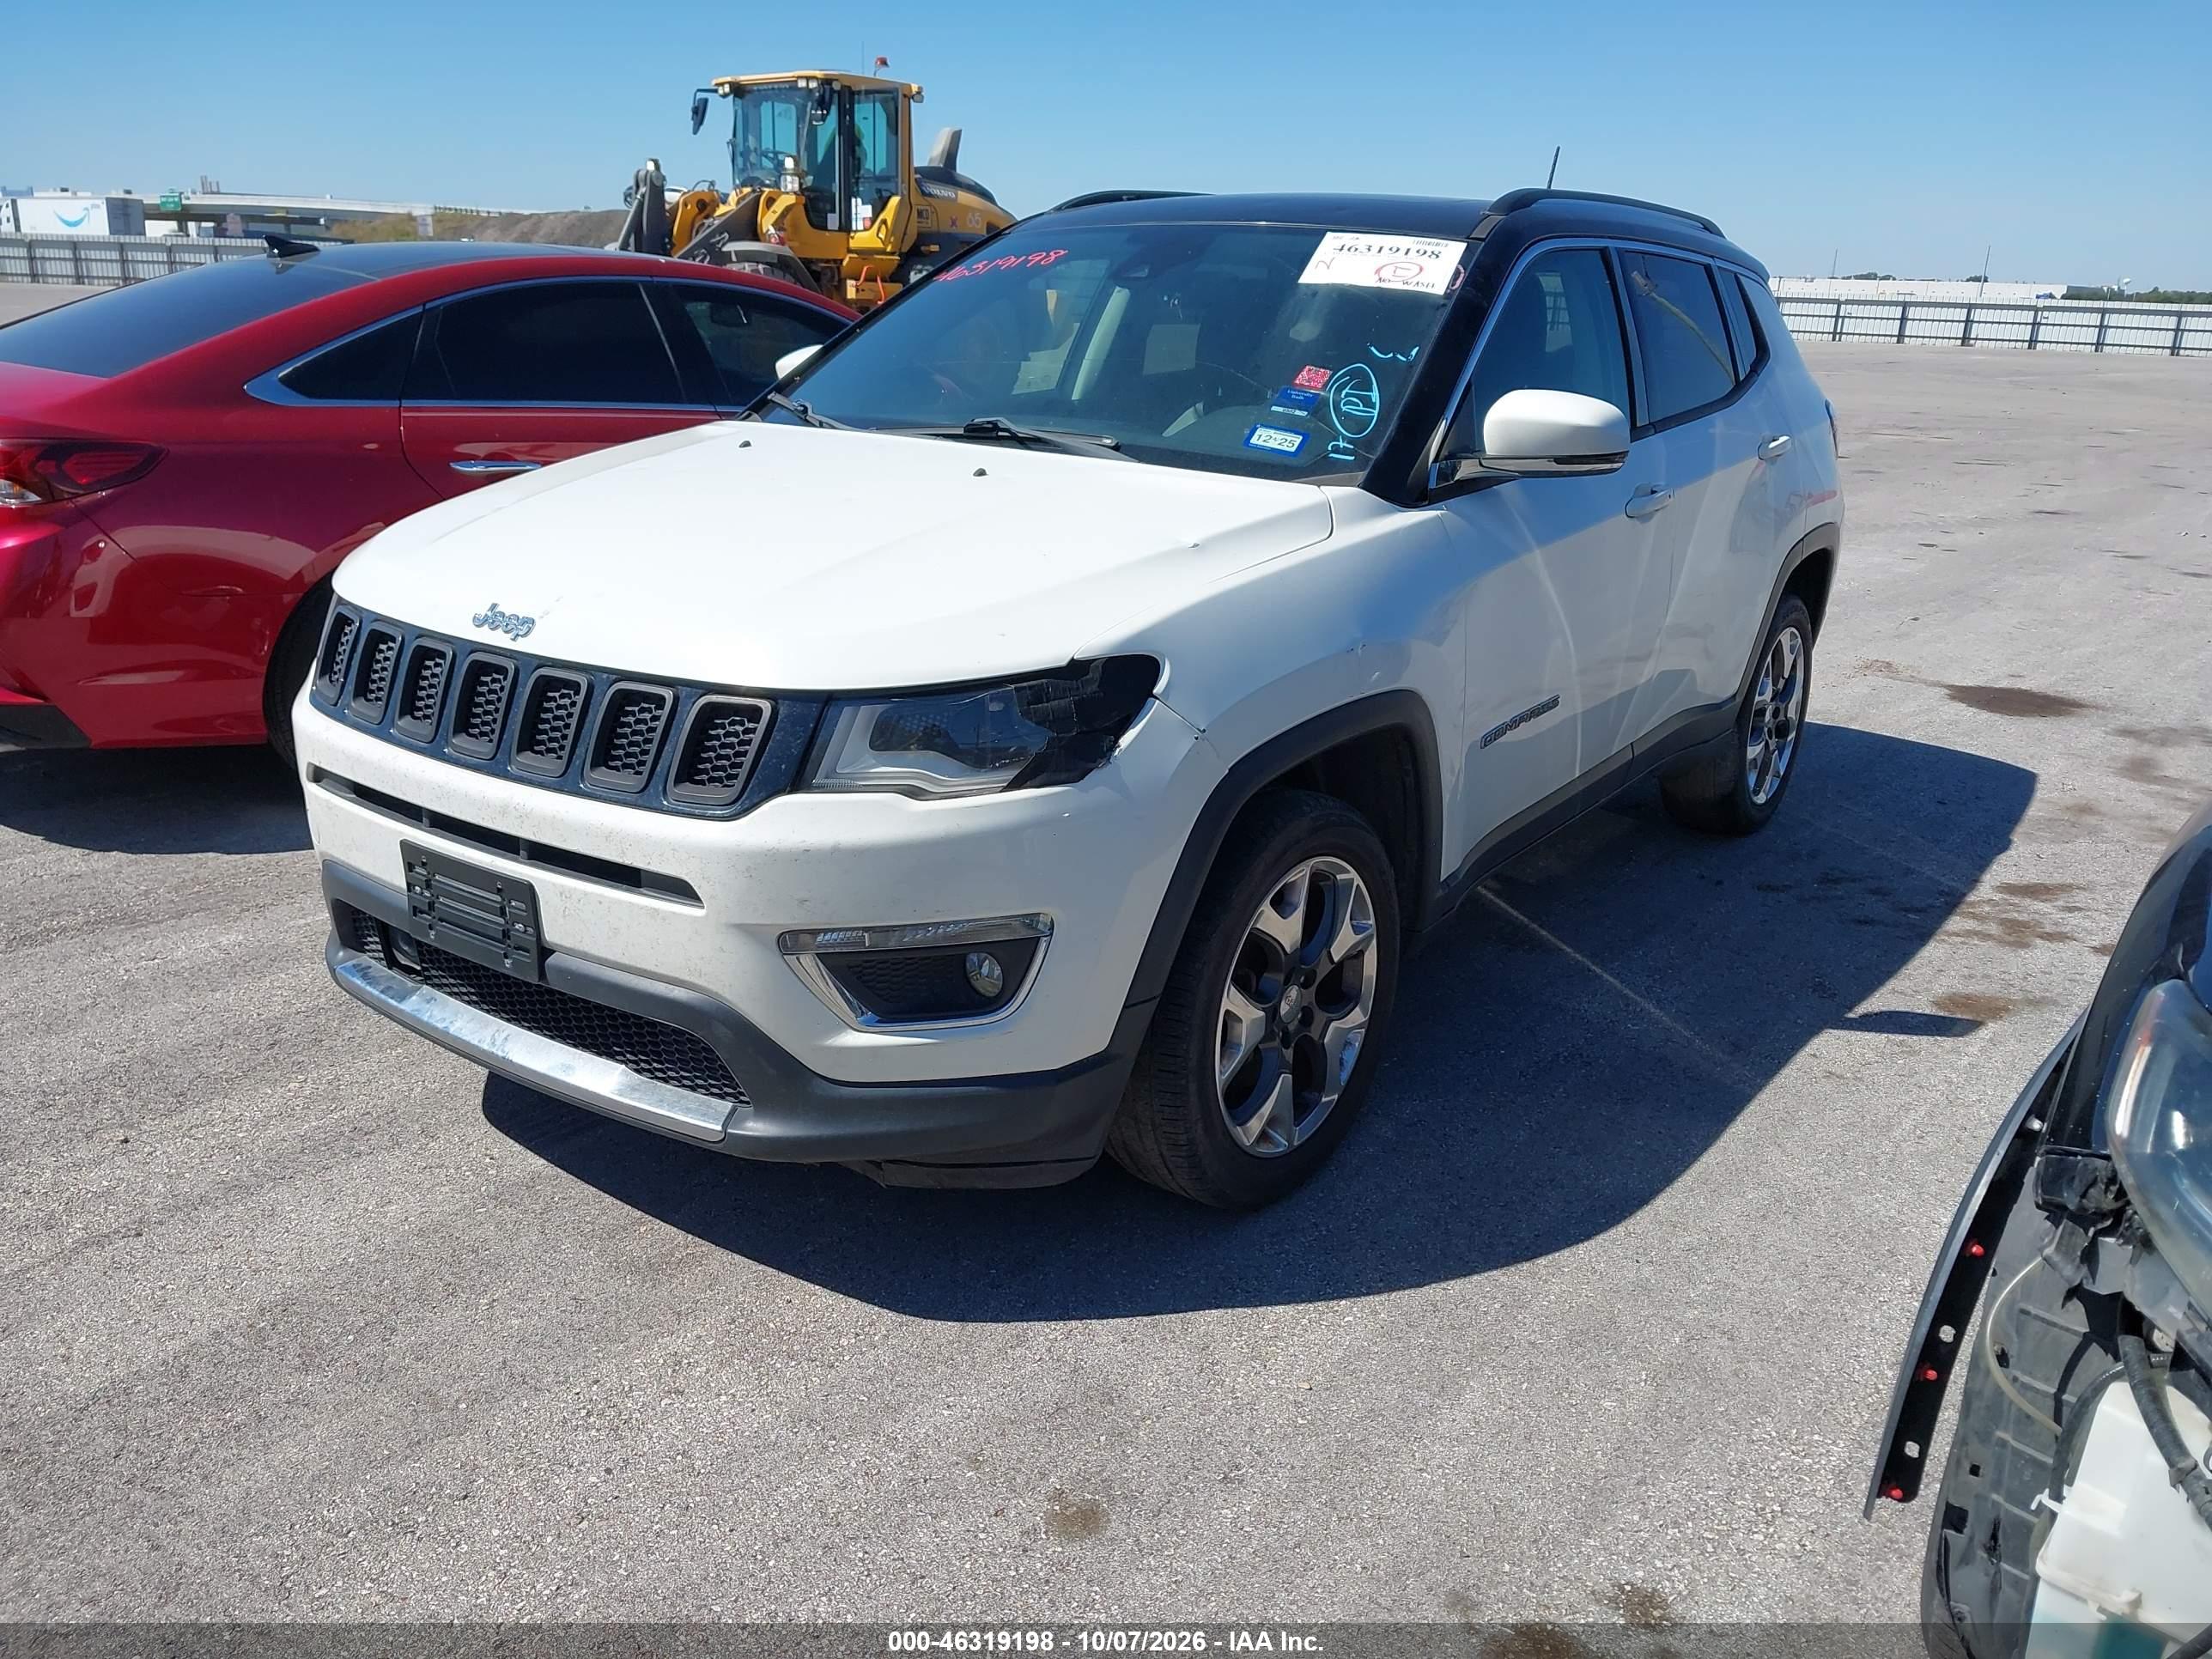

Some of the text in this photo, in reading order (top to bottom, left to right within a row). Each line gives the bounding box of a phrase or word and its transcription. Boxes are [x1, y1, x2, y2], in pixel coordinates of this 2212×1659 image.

[1333, 243, 1443, 260] 46319198
[472, 603, 536, 641] Jeep
[1480, 694, 1561, 750] COMPASS
